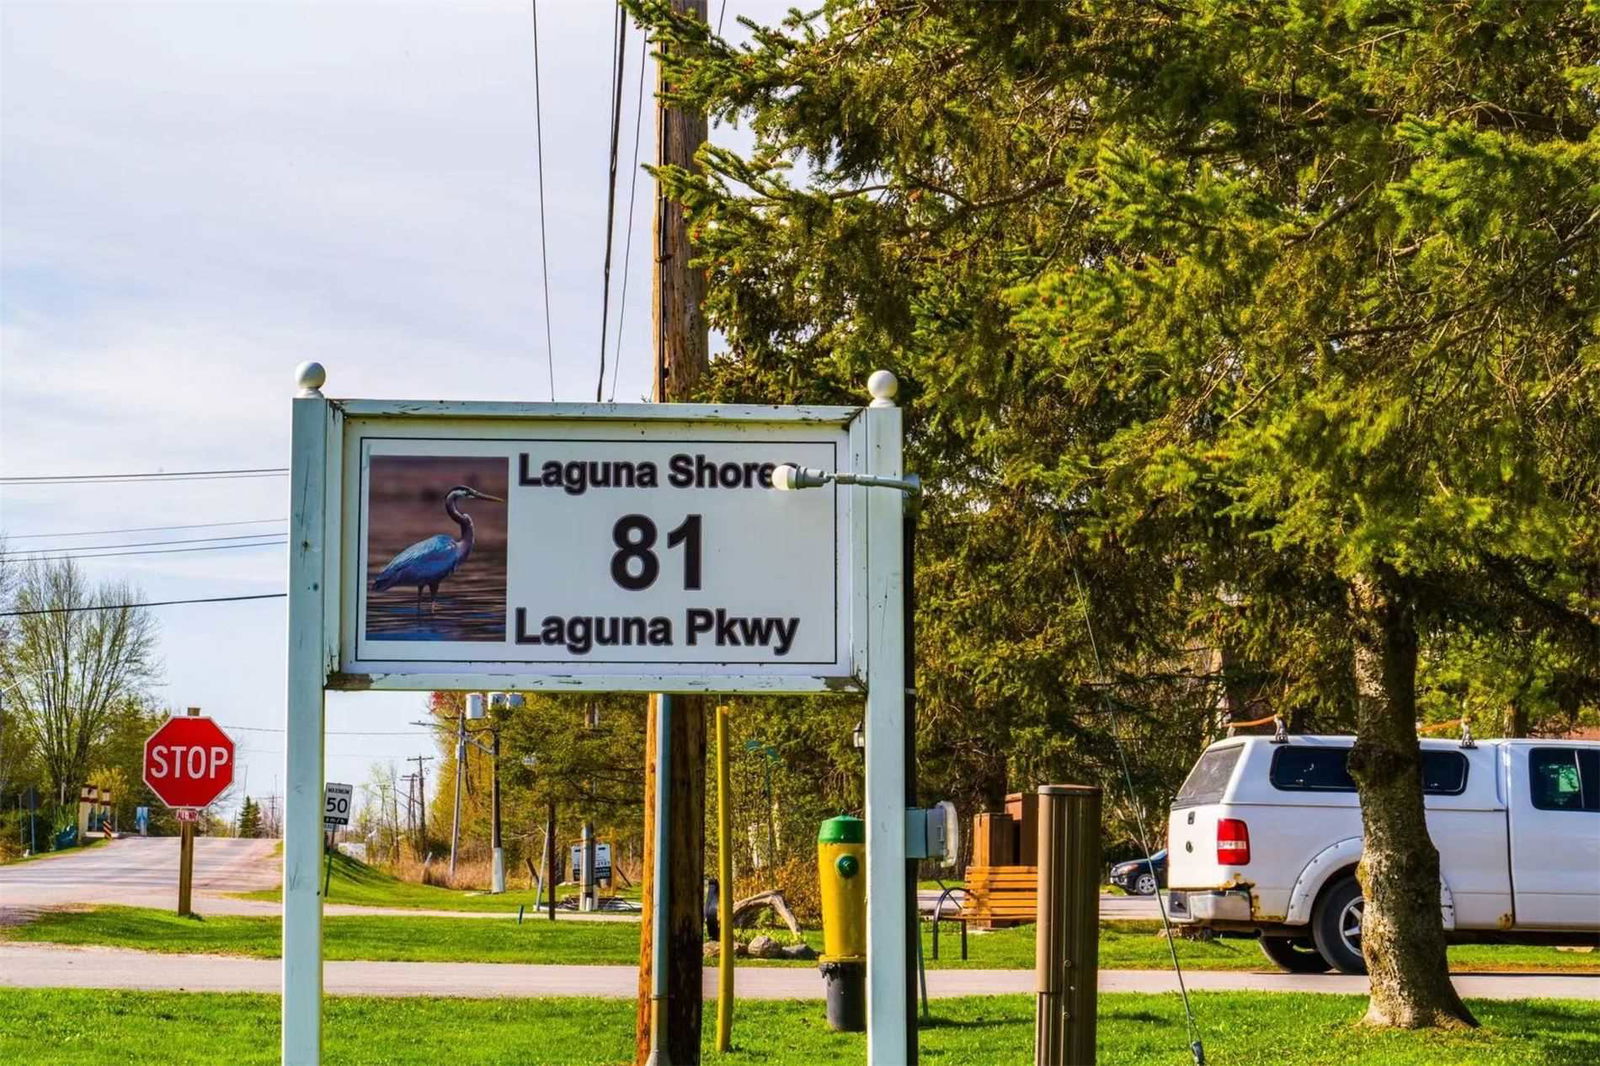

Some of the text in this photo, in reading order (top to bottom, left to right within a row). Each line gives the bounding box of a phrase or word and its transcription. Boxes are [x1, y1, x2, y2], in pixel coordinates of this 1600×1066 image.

[518, 452, 800, 496] Laguna Shore
[610, 513, 703, 592] 81
[514, 606, 801, 657] Laguna Pkwy
[150, 745, 229, 779] STOP
[326, 797, 348, 813] 50
